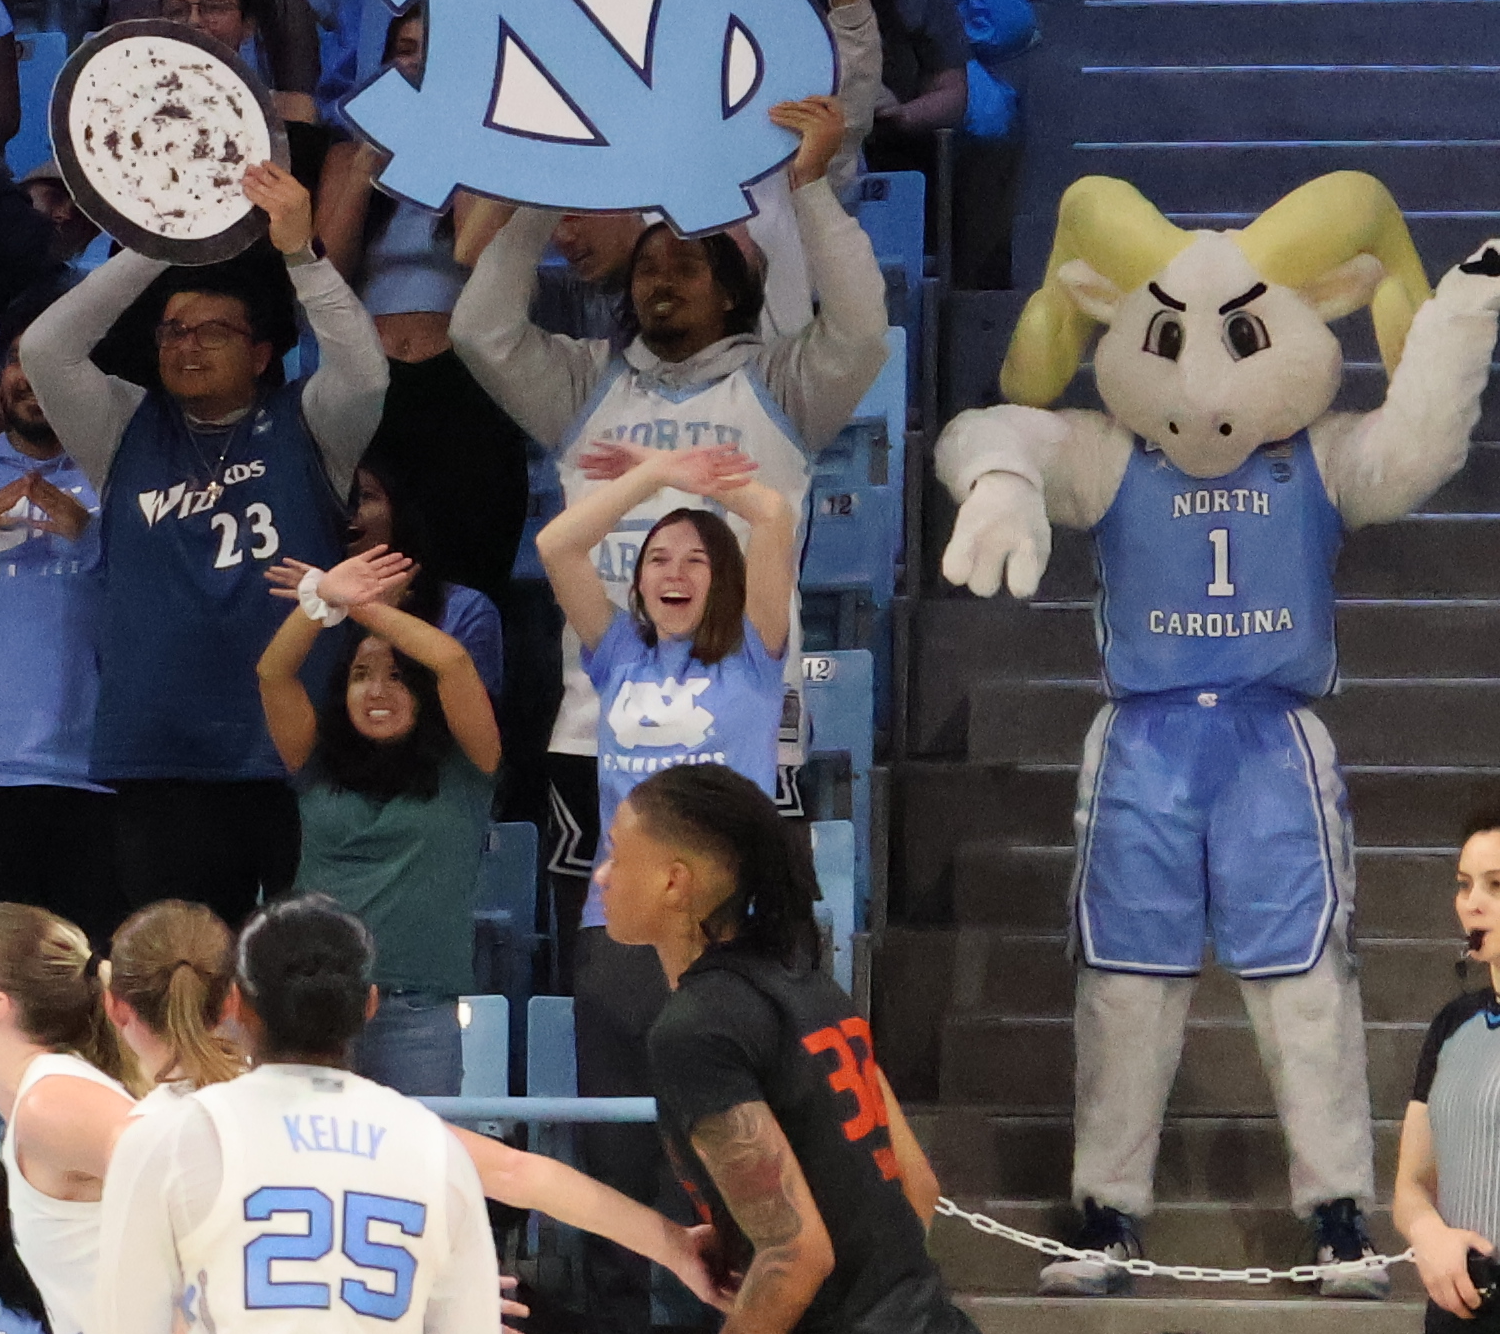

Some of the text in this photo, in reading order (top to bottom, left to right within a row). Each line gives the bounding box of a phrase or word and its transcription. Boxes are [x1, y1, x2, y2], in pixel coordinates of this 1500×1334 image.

[827, 495, 853, 516] 12
[1171, 489, 1271, 520] NORTH
[210, 500, 281, 571] 23
[1206, 527, 1236, 598] 1
[1148, 607, 1295, 638] CAROLINA
[806, 659, 831, 681] 12
[282, 1115, 384, 1158] KELLY
[243, 1185, 427, 1322] 25
